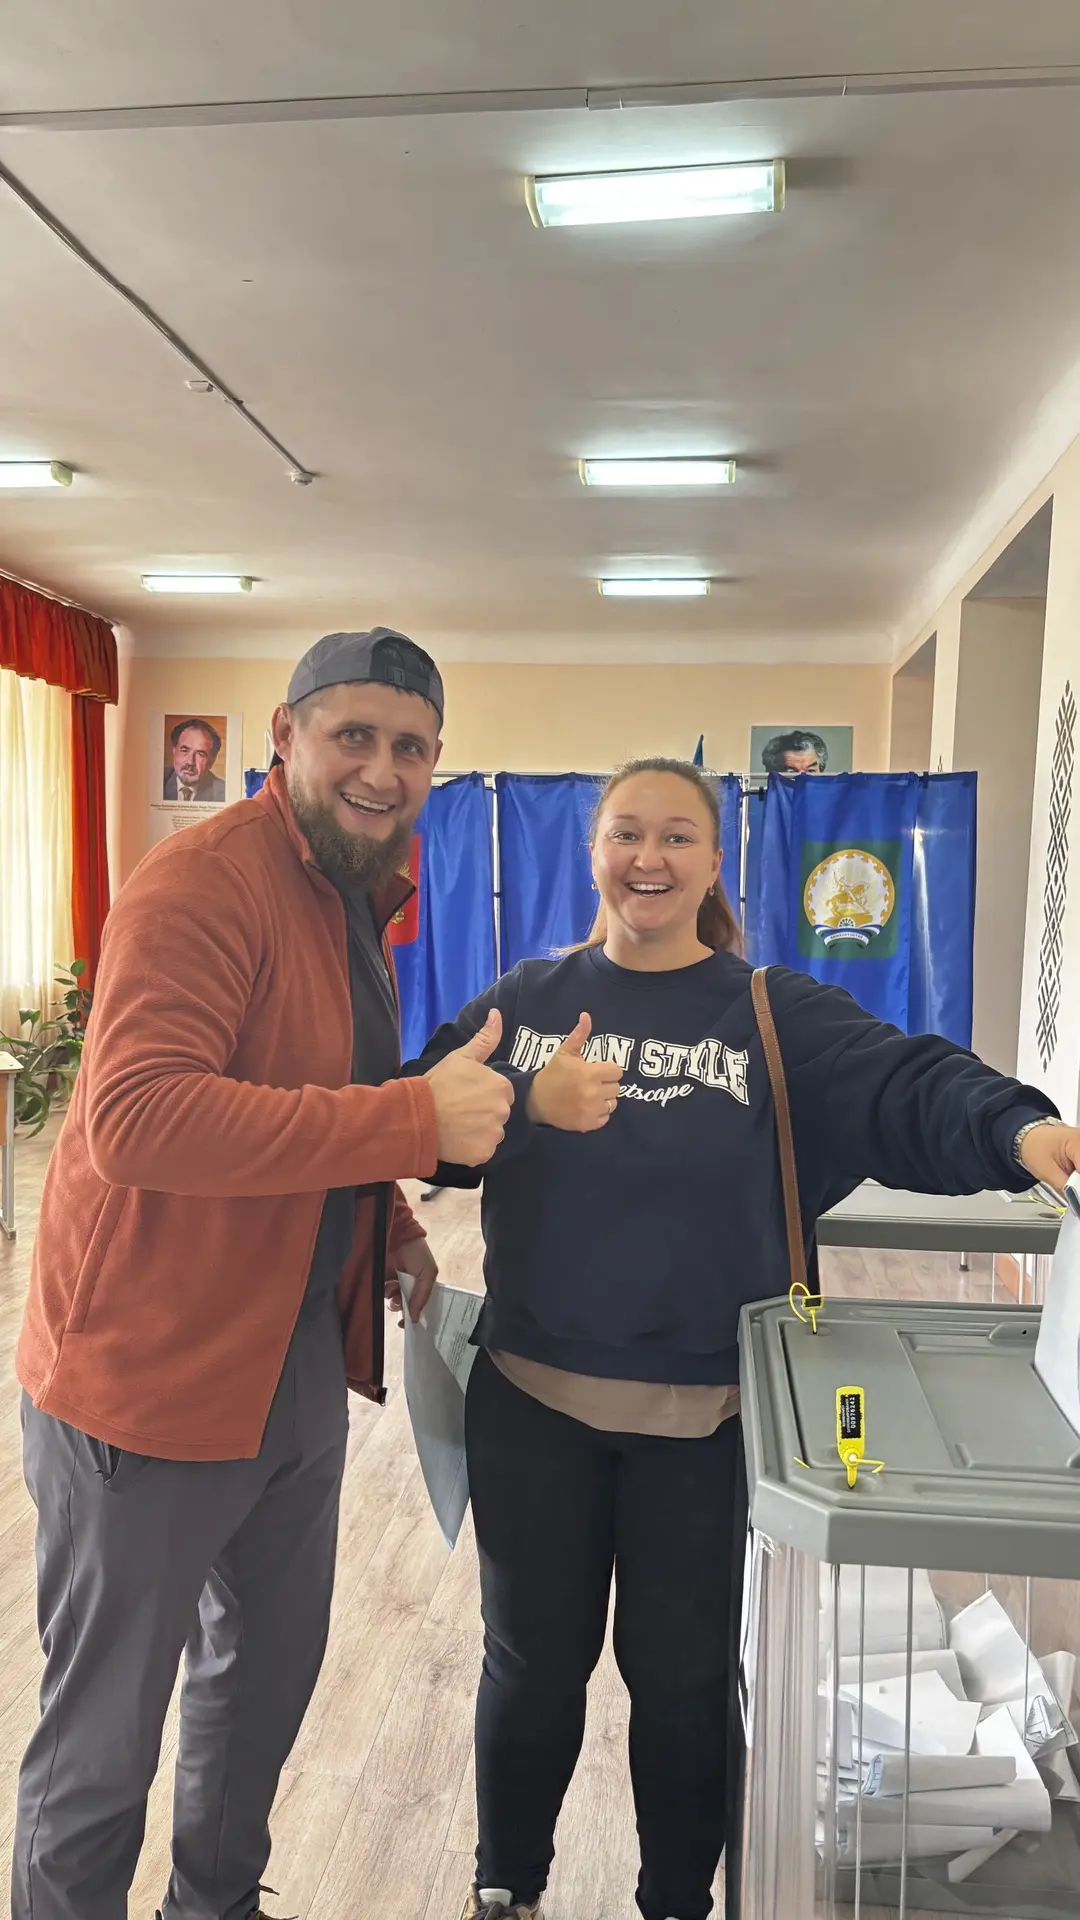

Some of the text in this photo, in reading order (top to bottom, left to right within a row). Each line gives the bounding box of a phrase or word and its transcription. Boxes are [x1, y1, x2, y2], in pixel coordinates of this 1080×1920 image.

[509, 1026, 749, 1105] URAN STYLE
[618, 1083, 694, 1107] etscape
